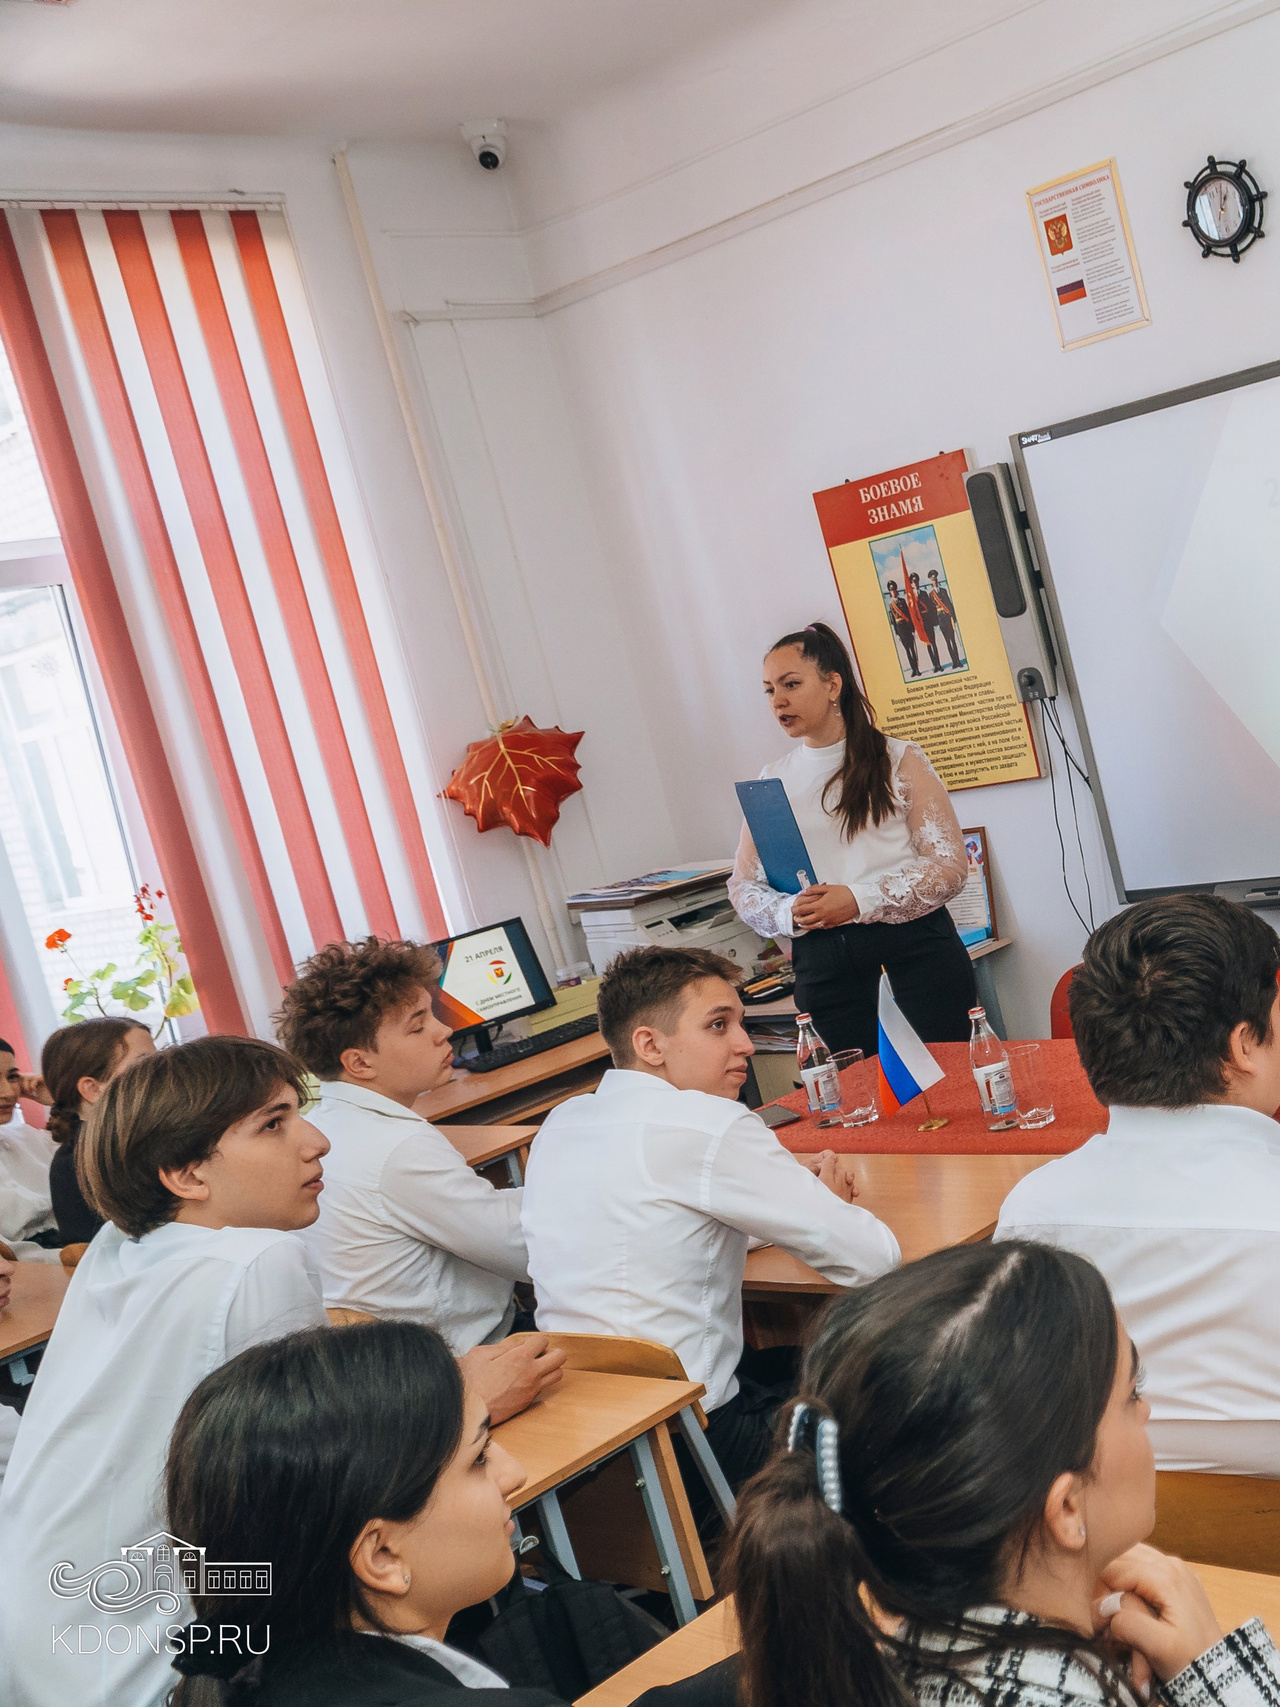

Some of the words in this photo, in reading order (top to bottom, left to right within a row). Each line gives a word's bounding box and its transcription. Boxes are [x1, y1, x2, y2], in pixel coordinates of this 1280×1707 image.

[858, 472, 922, 504] БОЕВОЕ
[867, 495, 925, 525] ЗНАМЯ
[891, 693, 924, 706] Вооруженных
[934, 686, 963, 696] Российской
[963, 680, 992, 691] Федерации
[907, 685, 924, 693] Боевое
[940, 677, 963, 687] воинской
[912, 700, 934, 709] воинской
[950, 692, 974, 702] доблести
[886, 714, 905, 722] Боевые
[925, 706, 951, 716] вручаются
[951, 702, 975, 710] воинским
[916, 713, 959, 726] представителями
[959, 705, 994, 717] Министерства
[994, 701, 1017, 711] обороны
[918, 723, 945, 734] Федерации
[981, 710, 1011, 721] Российской
[910, 734, 928, 743] Боевое
[944, 727, 973, 737] сохраняется
[980, 720, 1004, 730] воинской
[955, 734, 981, 743] изменения
[982, 727, 1017, 738] наименования
[947, 744, 972, 753] находится
[967, 749, 986, 757] личный
[1004, 741, 1028, 751] воинской
[970, 756, 1001, 766] мужественно
[1002, 751, 1027, 760] защищать
[965, 766, 990, 776] допустить
[999, 761, 1018, 769] захвата
[475, 945, 504, 960] АПРЕЛЯ
